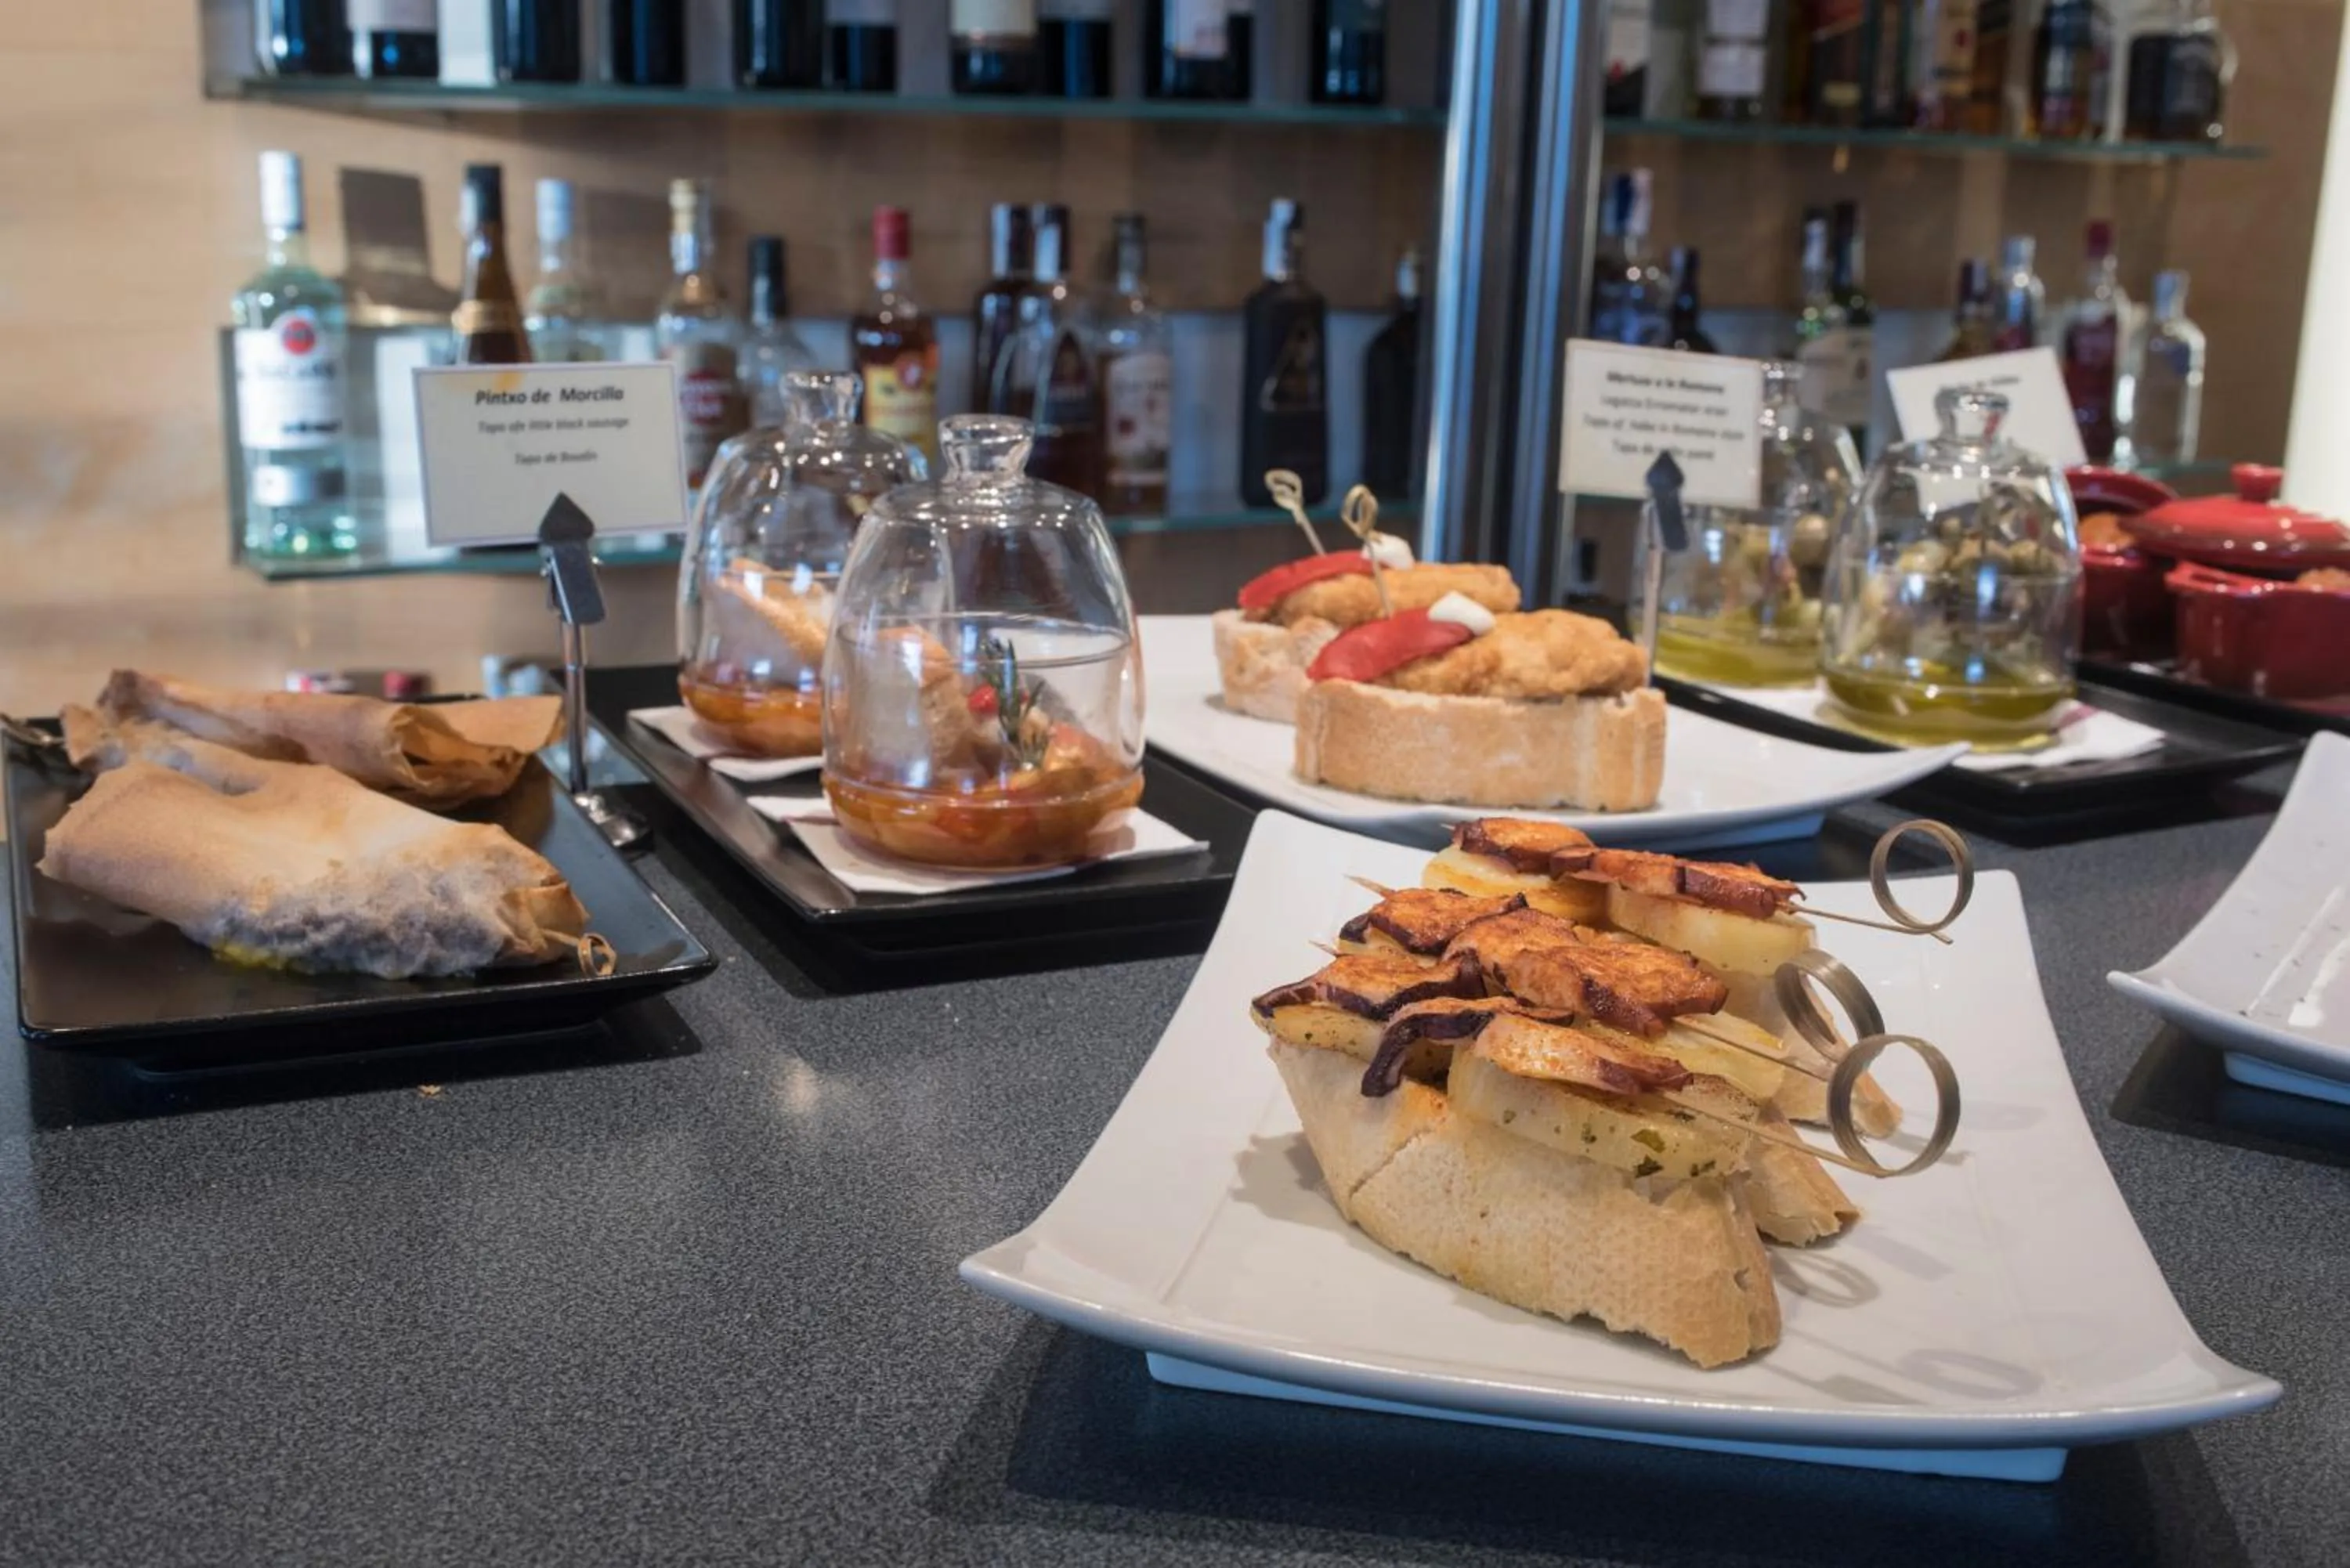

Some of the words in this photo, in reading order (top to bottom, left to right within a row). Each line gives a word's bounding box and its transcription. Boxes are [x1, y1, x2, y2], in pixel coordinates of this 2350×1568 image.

[475, 390, 527, 406] Pintxo
[531, 388, 551, 404] de
[559, 386, 624, 403] Morcilla
